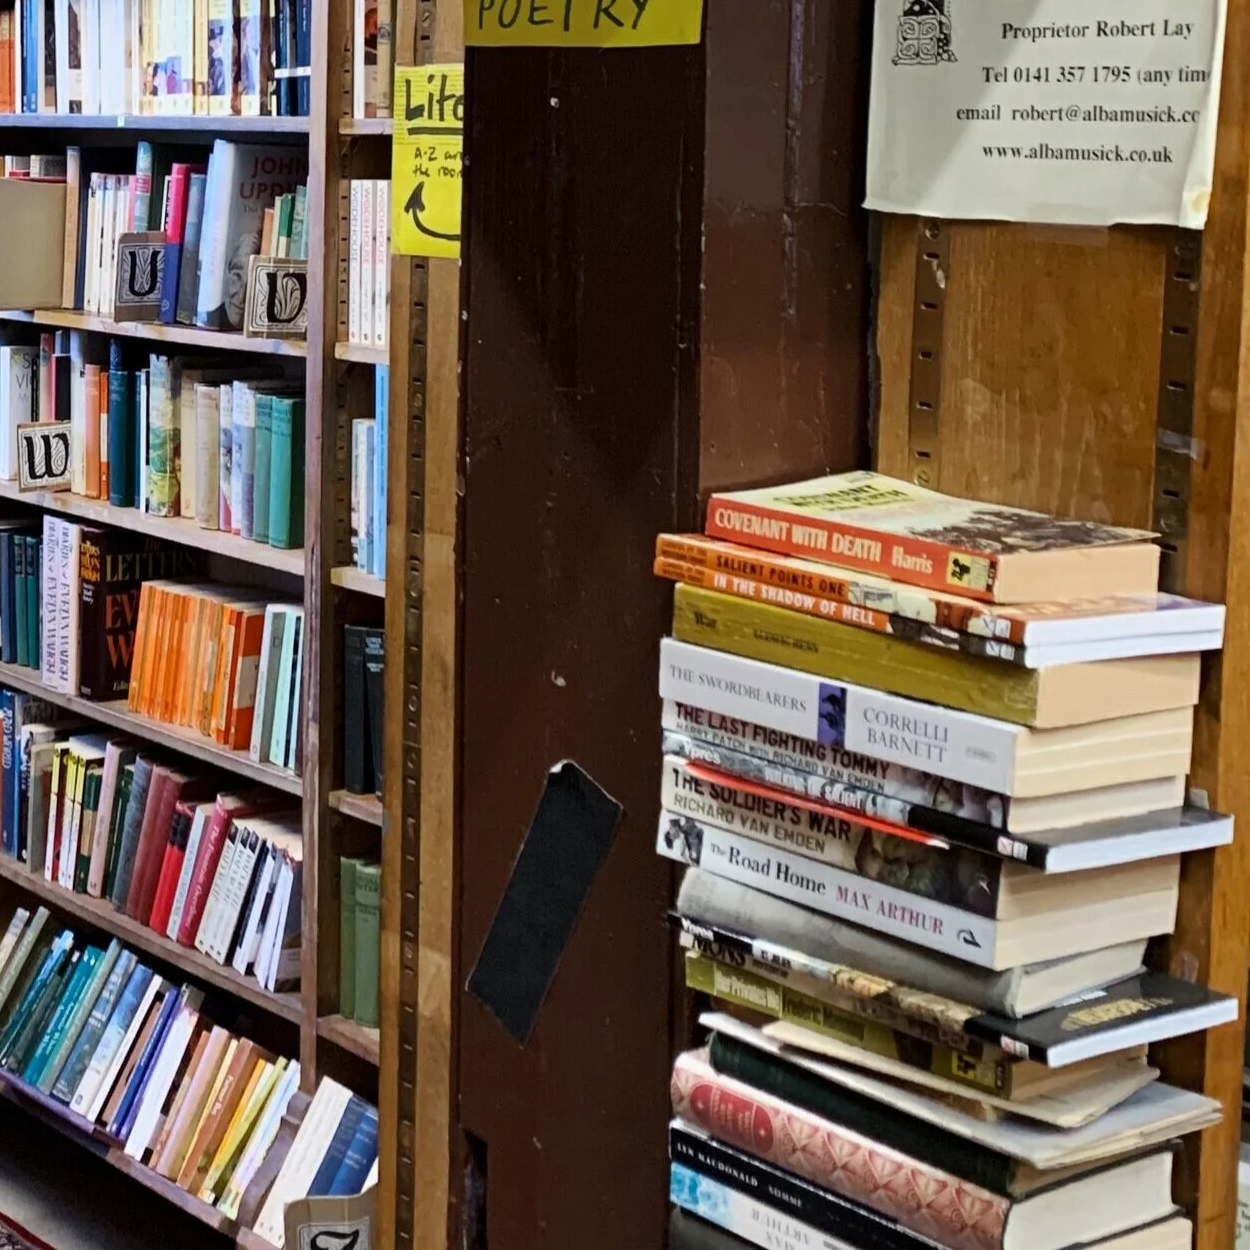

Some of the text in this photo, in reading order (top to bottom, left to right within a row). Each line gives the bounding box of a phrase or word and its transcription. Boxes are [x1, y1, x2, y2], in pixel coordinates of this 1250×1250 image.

[1001, 19, 1194, 42] Proprietor Robert Lay
[982, 66, 1009, 84] Tel
[1013, 65, 1051, 83] 0141
[1056, 66, 1086, 83] 357
[1093, 66, 1131, 83] 1795
[1137, 68, 1173, 87] (any
[956, 105, 1002, 121] email
[413, 163, 430, 178] the
[415, 146, 437, 161] A-Z
[982, 144, 1173, 164] www.albamusick.co.uk
[351, 186, 359, 262] WODEHOUSE
[128, 249, 162, 297] U
[24, 433, 69, 479] W
[715, 506, 933, 575] COVENANT WITH DEATH Harris
[714, 572, 727, 588] IN
[732, 578, 755, 597] THE
[761, 584, 813, 610] SHADOW
[821, 599, 837, 617] OF
[842, 604, 875, 626] HELL
[717, 555, 765, 579] SALIENT
[770, 568, 813, 590] POINTS
[820, 579, 845, 596] ONE
[46, 576, 57, 624] EVELYN
[59, 582, 70, 630] EVELYN
[670, 664, 806, 712] THE SWORDBEARERS
[676, 702, 890, 780] THE LAST FIGHTING TOMMY
[863, 706, 948, 743] CORRELLI
[868, 727, 947, 763] BARNETT
[676, 721, 709, 741] HARRY
[713, 731, 746, 751] PATCH
[773, 747, 818, 772] RICHARD
[822, 761, 844, 778] VAN
[847, 769, 885, 794] EMDEN
[672, 769, 851, 842] THE SOLDIER'S WAR
[672, 793, 826, 855] RICHARD VAN EMDEN
[728, 845, 771, 877] Road
[775, 860, 827, 896] Home
[836, 884, 872, 912] MAX
[876, 900, 944, 936] ARTHUR
[677, 1141, 803, 1209] LYN MACDONALD SOMME
